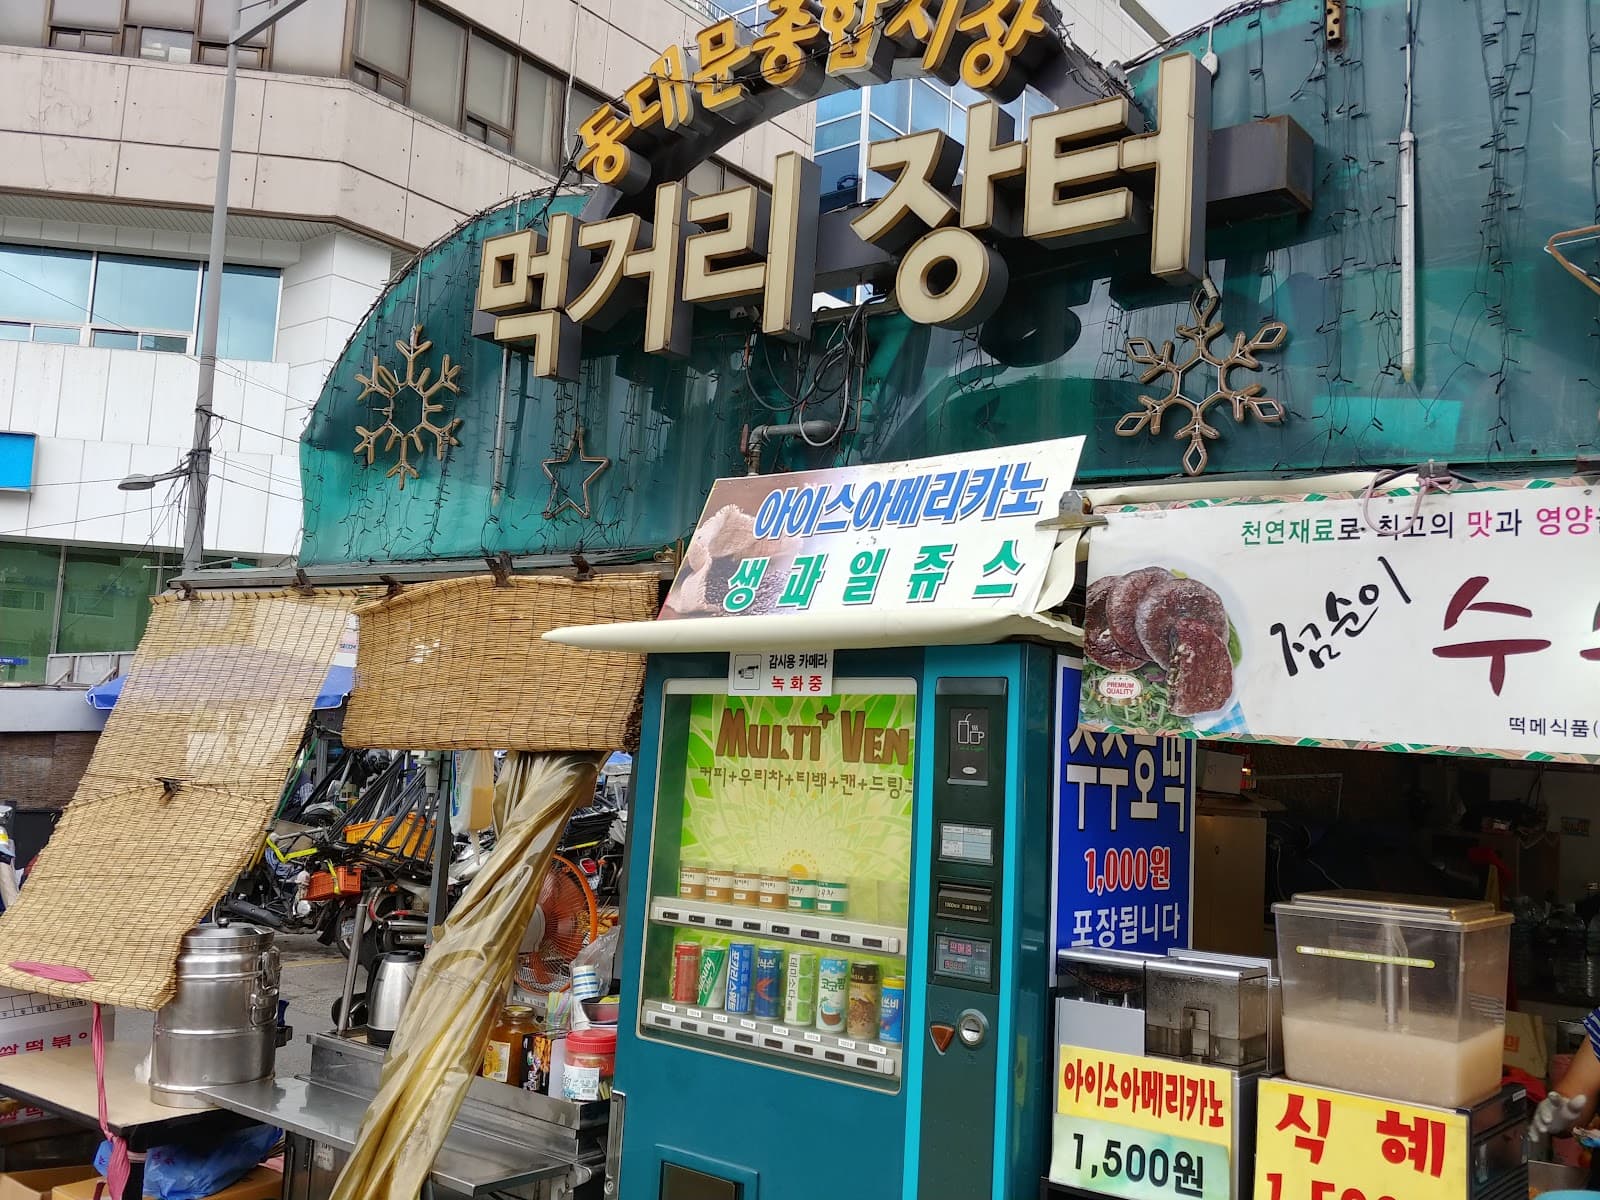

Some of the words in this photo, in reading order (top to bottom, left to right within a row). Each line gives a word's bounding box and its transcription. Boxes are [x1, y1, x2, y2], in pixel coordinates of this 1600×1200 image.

[577, 0, 1046, 185] 동대문종합시장
[478, 151, 804, 378] 먹거리
[850, 53, 1197, 327] 장터
[753, 461, 1048, 540] 아이스아메리카노
[1240, 517, 1361, 546] 천연재료로
[1376, 511, 1454, 541] 최고의
[1467, 508, 1522, 538] 맛과
[1536, 505, 1600, 537] 영양
[769, 653, 796, 670] 감시용
[798, 652, 828, 669] 카메라
[1106, 681, 1135, 689] PREMIUM
[1106, 687, 1134, 695] QUALITY
[1084, 846, 1172, 896] 1,000원
[1071, 902, 1181, 948] 포장됩니다
[821, 977, 846, 992] 코코팜
[1063, 1058, 1225, 1129] 아이스아메리카노
[1072, 1132, 1204, 1199] 1,500원
